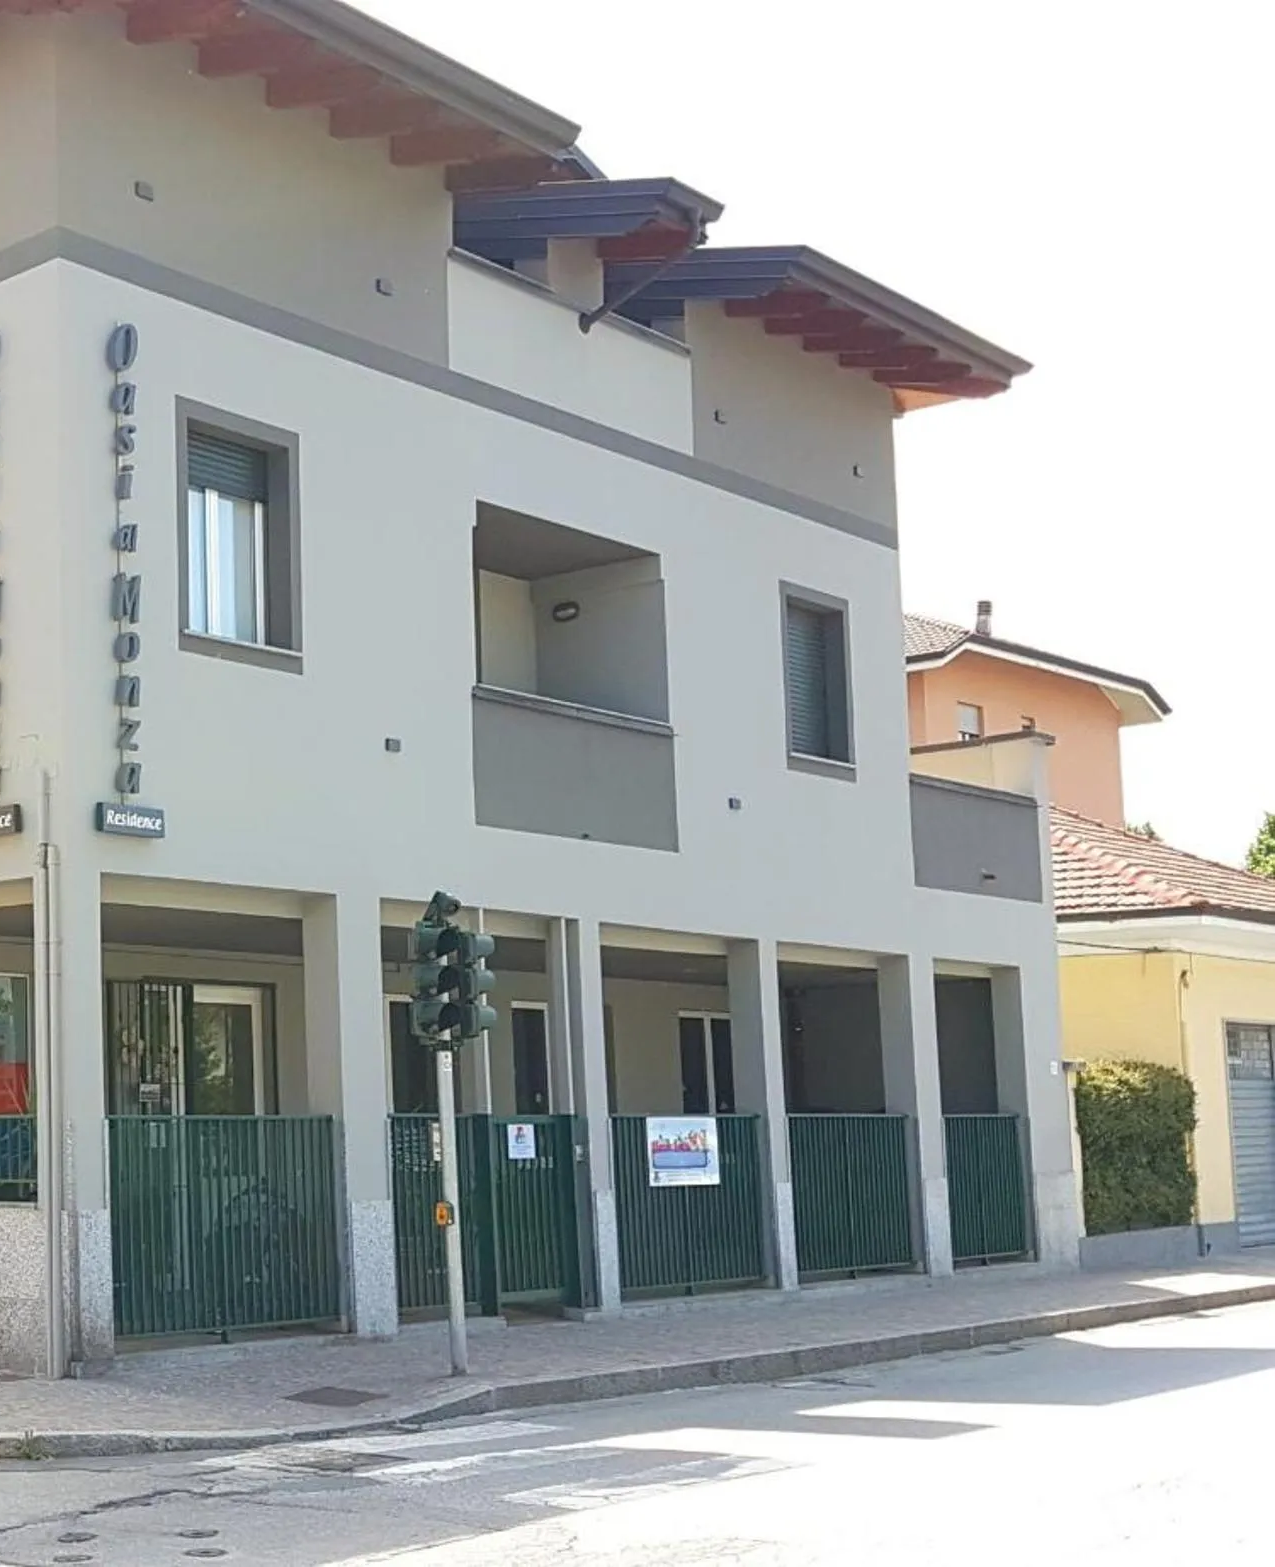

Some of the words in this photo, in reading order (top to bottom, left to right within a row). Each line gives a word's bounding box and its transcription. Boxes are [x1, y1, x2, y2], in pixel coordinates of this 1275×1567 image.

[107, 323, 139, 500] Oasi
[112, 572, 141, 795] Monza
[106, 809, 163, 831] Residence
